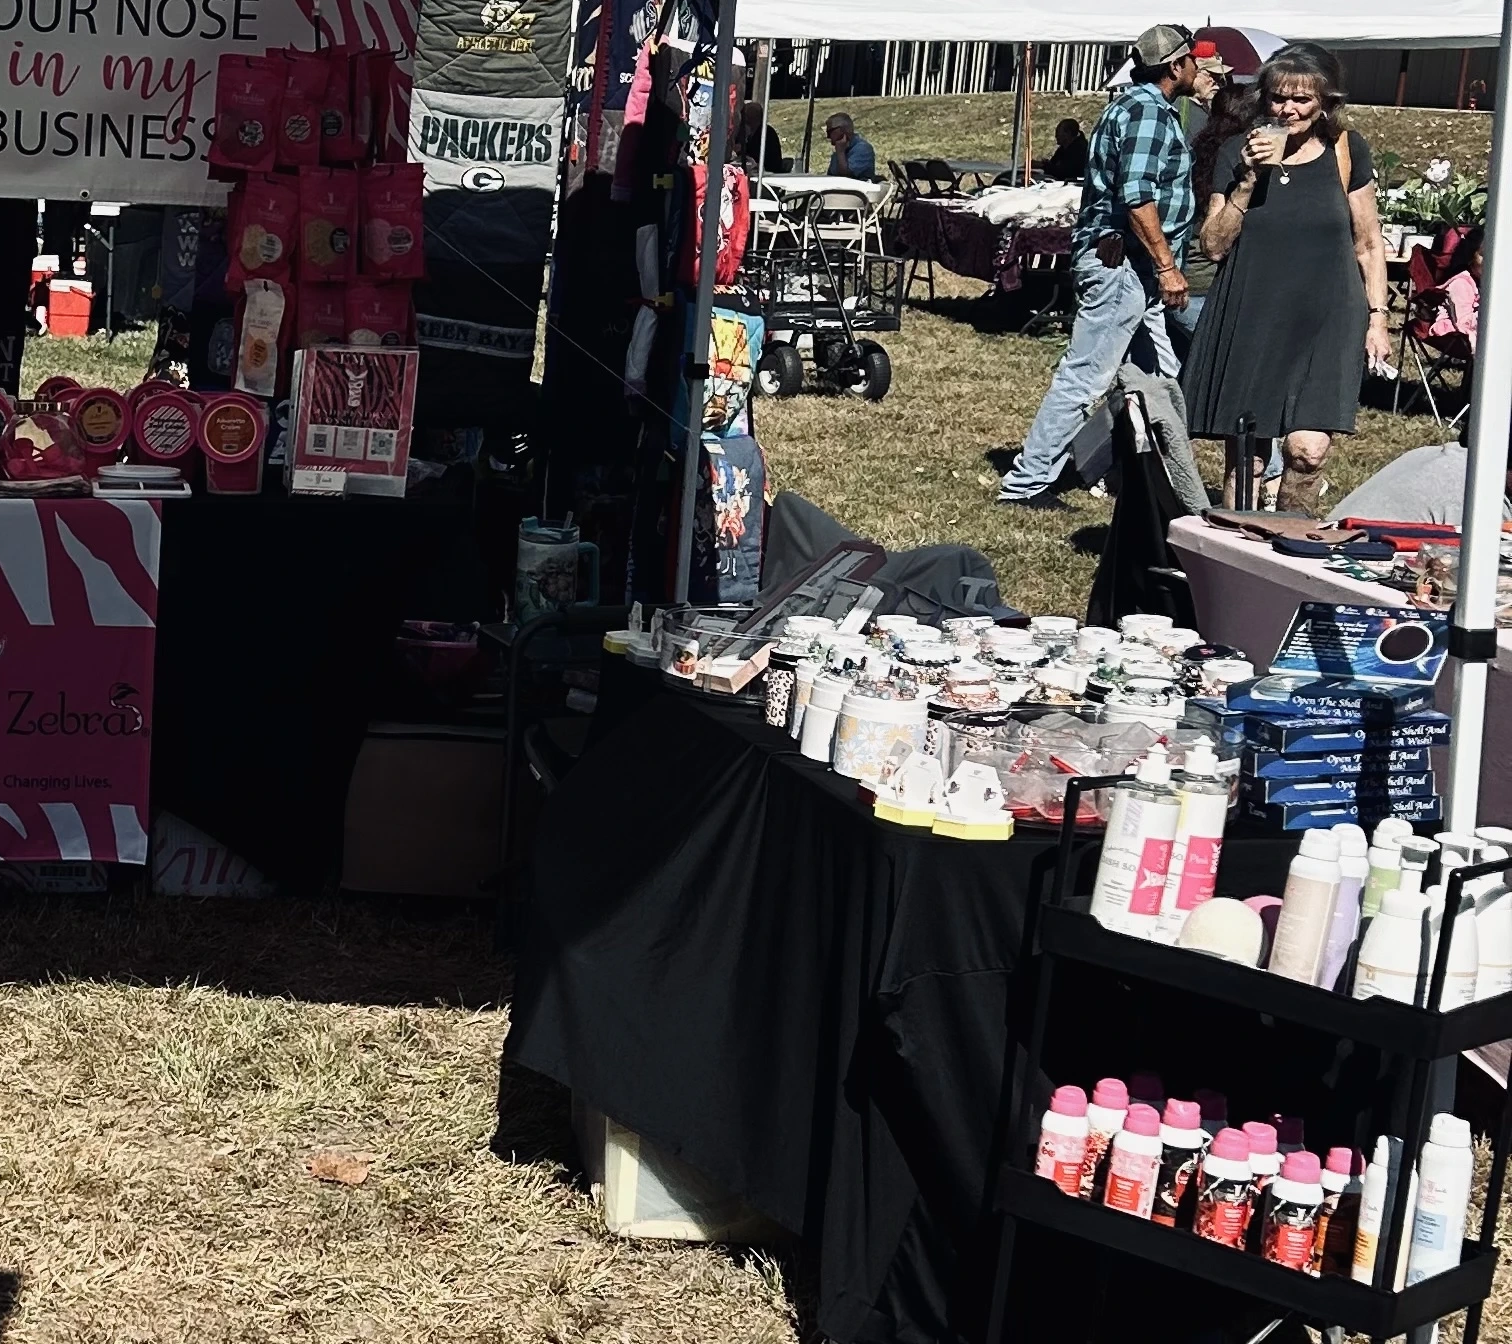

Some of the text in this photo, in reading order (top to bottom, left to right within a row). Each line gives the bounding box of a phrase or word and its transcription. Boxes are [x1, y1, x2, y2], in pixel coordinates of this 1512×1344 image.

[7, 41, 212, 145] in my
[417, 114, 553, 163] PACKERS
[418, 320, 523, 350] REEN BAY
[6, 683, 144, 737] Zebra
[3, 774, 71, 791] Changing
[74, 775, 113, 789] Lives.
